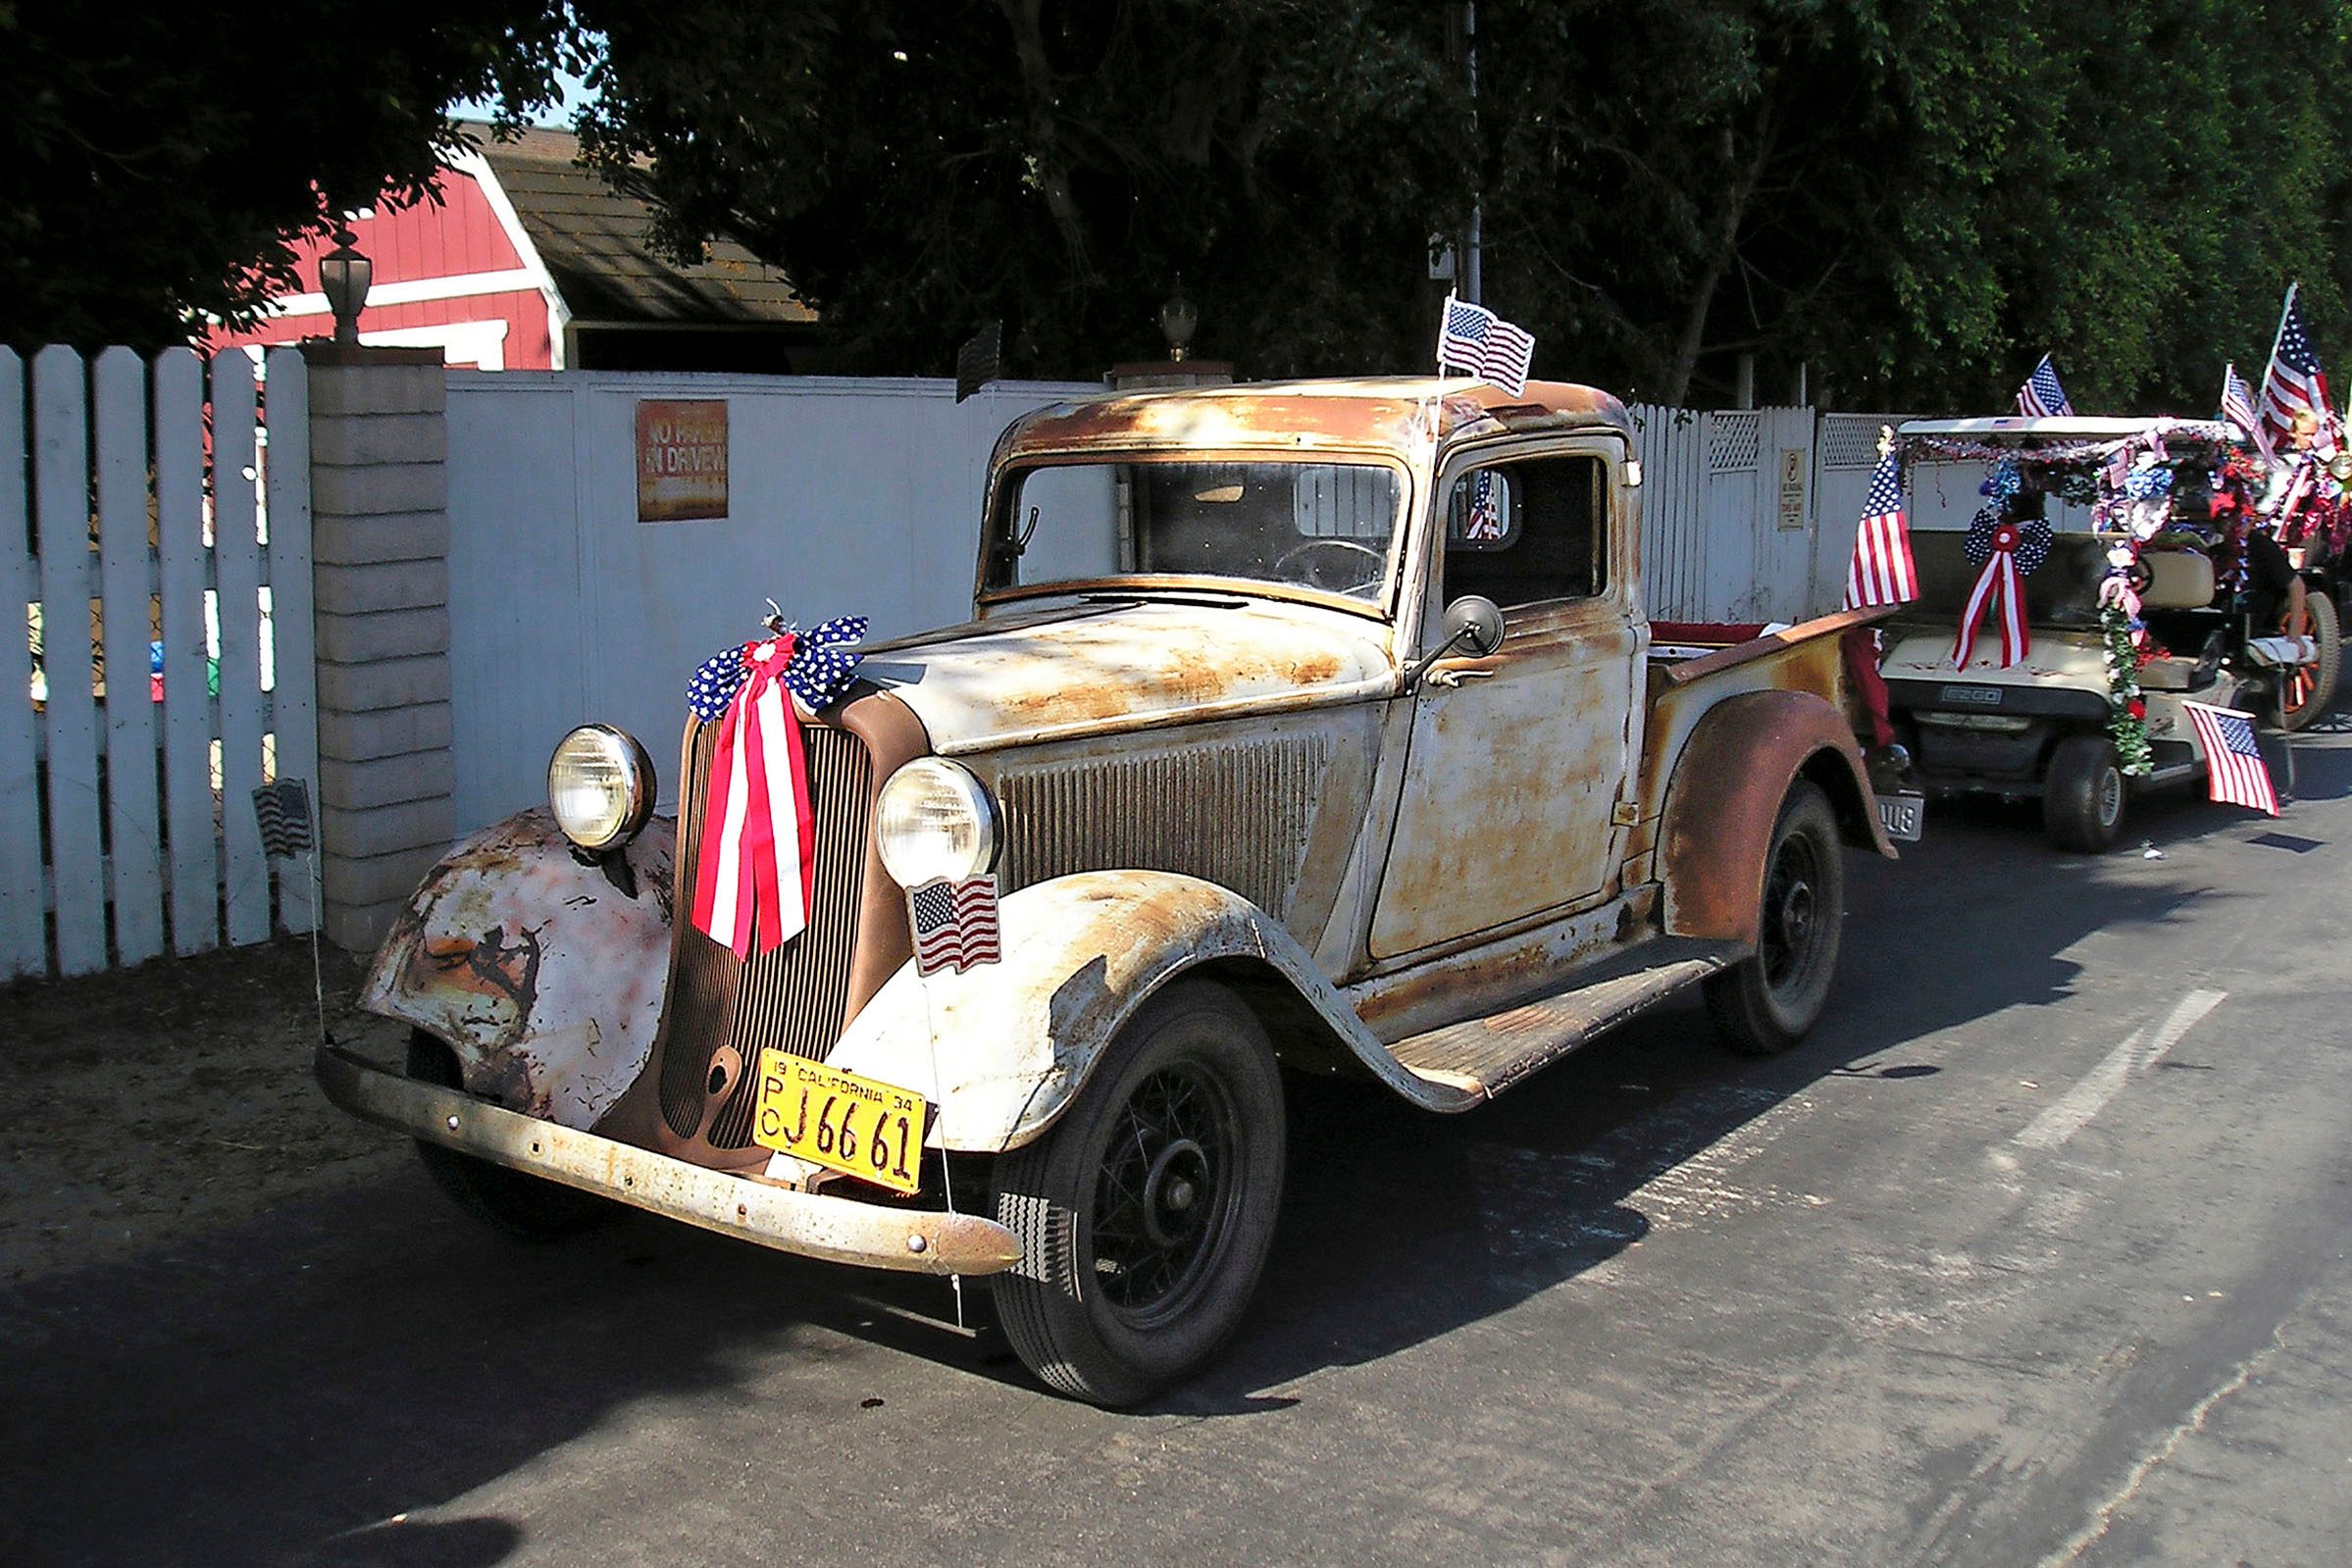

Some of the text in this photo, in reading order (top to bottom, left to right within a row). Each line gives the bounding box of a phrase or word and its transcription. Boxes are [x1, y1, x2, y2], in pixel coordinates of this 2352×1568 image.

[774, 1061, 913, 1112] 19 CALIFORNIA 34
